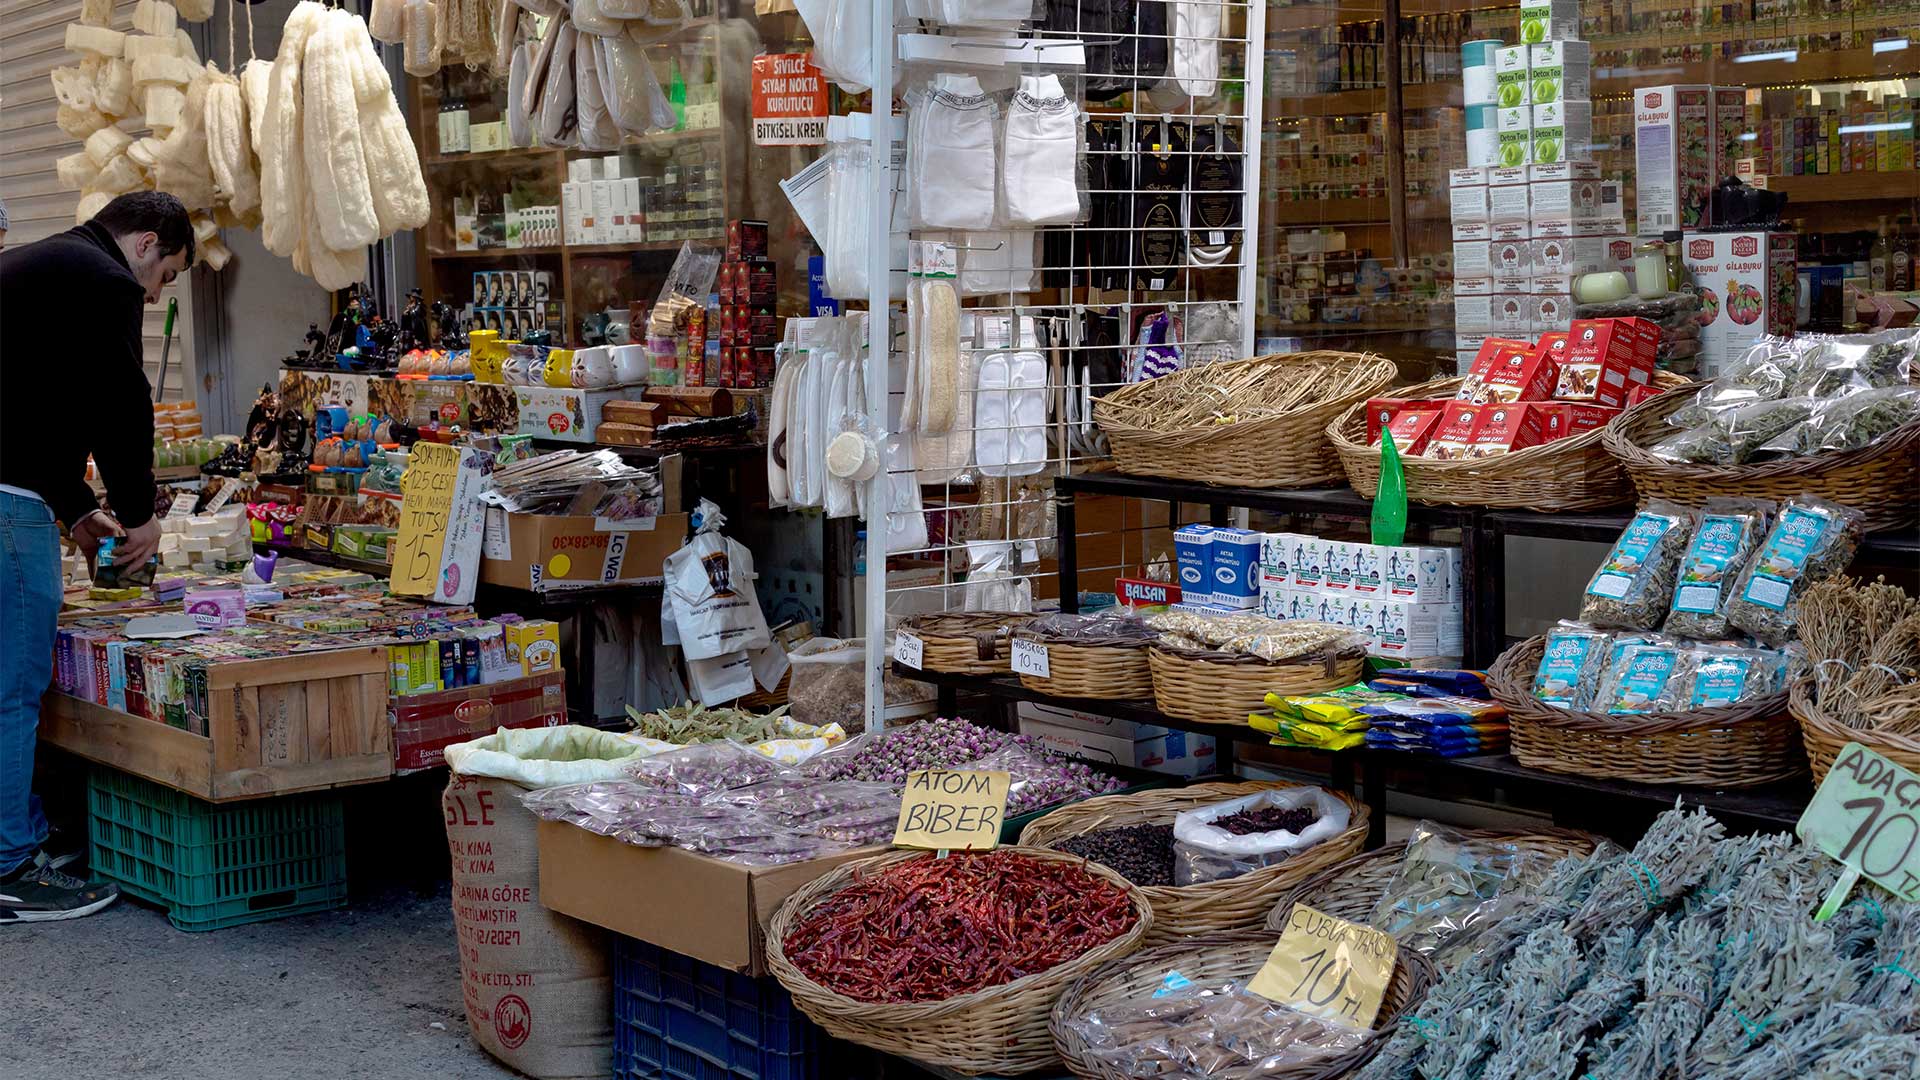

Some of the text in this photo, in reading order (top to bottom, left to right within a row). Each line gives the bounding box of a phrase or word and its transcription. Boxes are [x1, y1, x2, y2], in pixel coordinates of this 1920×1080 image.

[1523, 10, 1538, 18] Detox
[1498, 74, 1514, 83] Detox
[1534, 70, 1550, 78] Detox
[762, 77, 818, 93] SİYAH NOKTA
[767, 96, 813, 112] KURUTUCU
[757, 122, 824, 138] BİTKİSEL KREM
[1536, 129, 1551, 138] Detox
[1501, 133, 1517, 142] Detox
[1688, 264, 1719, 272] İLABURU
[1726, 261, 1762, 271] GİLABURU
[816, 306, 834, 316] VISA
[611, 534, 625, 554] LC
[406, 534, 434, 581] 15
[1125, 583, 1166, 602] BALSAN
[899, 648, 908, 660] 10
[1019, 653, 1030, 668] 10
[913, 771, 990, 795] ATOM
[904, 801, 998, 834] BİBER
[1840, 797, 1919, 878] 10
[467, 842, 492, 856] KINA
[470, 860, 494, 874] KINA
[492, 884, 530, 902] GÖRE
[482, 974, 492, 985] VE
[1290, 948, 1352, 1006] 10
